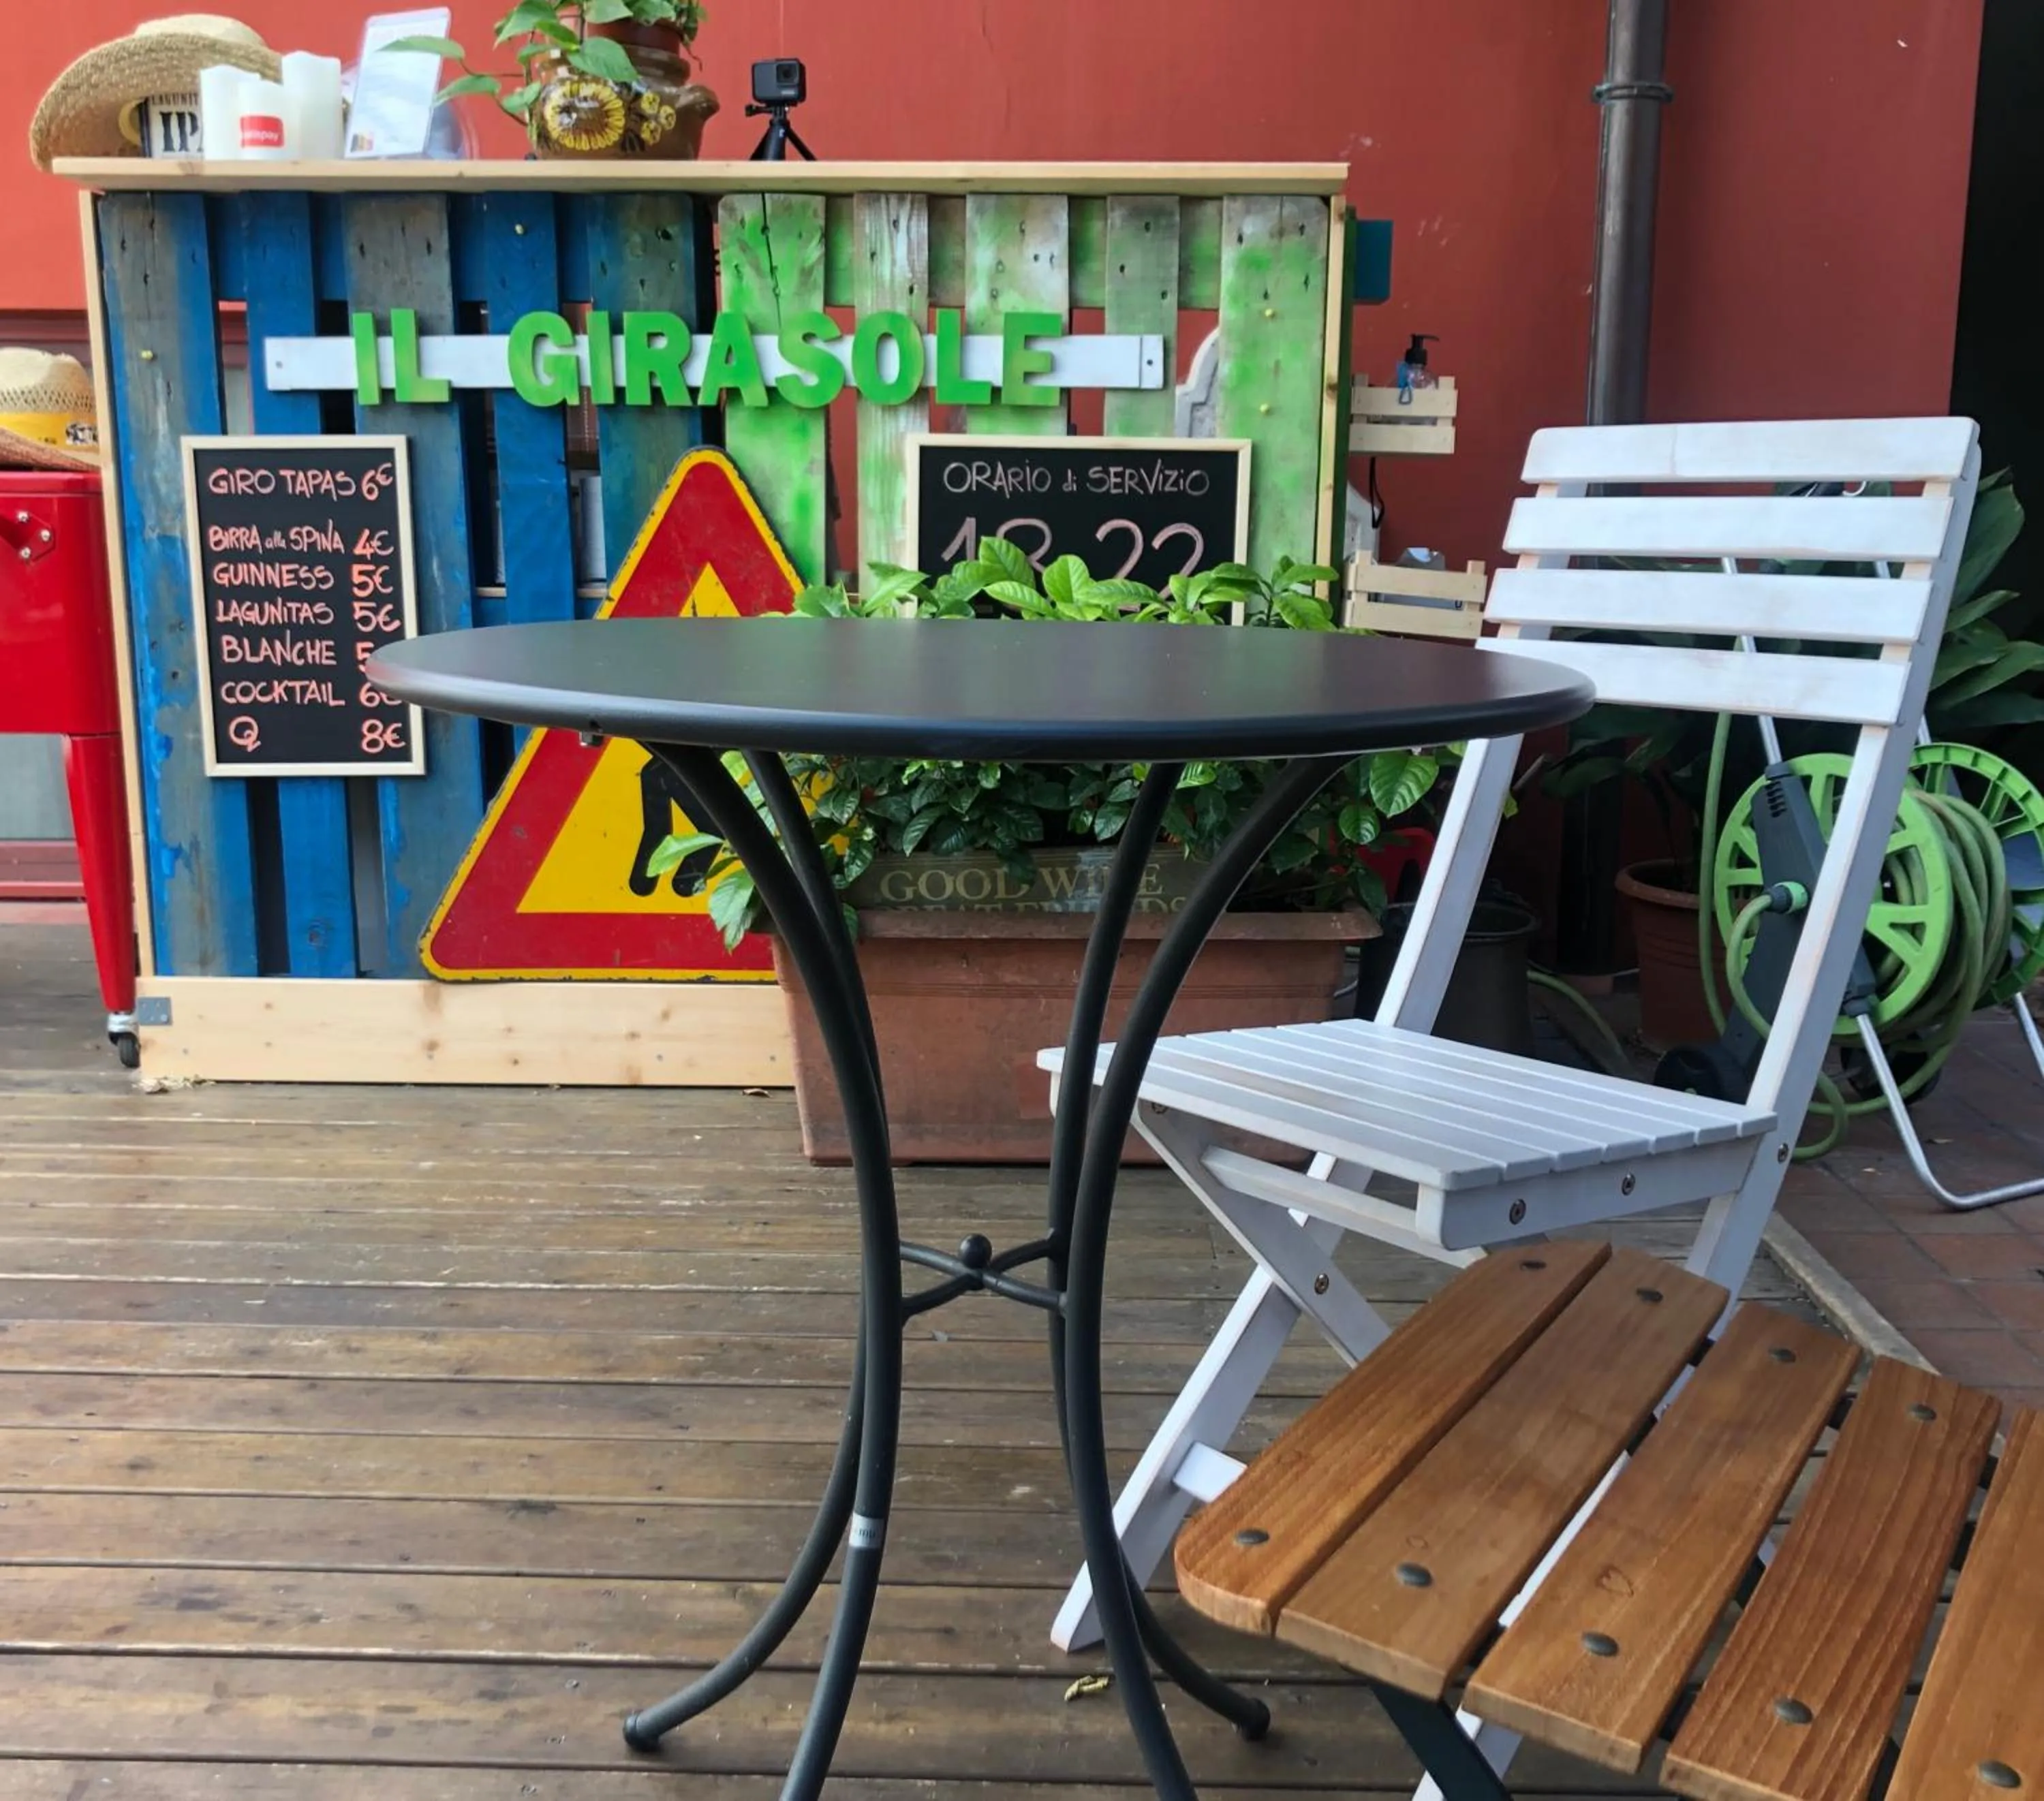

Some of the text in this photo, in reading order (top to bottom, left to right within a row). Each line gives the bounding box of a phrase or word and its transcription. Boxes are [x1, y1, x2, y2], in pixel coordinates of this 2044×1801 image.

[151, 92, 199, 106] LAGUNIT
[159, 110, 203, 153] IP
[352, 308, 1063, 408] IL GIRASOLE
[208, 467, 275, 495] GIRO
[278, 469, 357, 501] TAPAS
[1062, 468, 1078, 493] di
[208, 524, 263, 554] BIRRA
[289, 518, 345, 554] SPINA
[352, 527, 395, 560] 4€
[212, 562, 394, 598] GUINNESS 5€
[352, 600, 402, 633] 5€
[221, 629, 337, 666] BLANCHE
[220, 679, 346, 707] COCKTAIL
[360, 719, 407, 754] 8€
